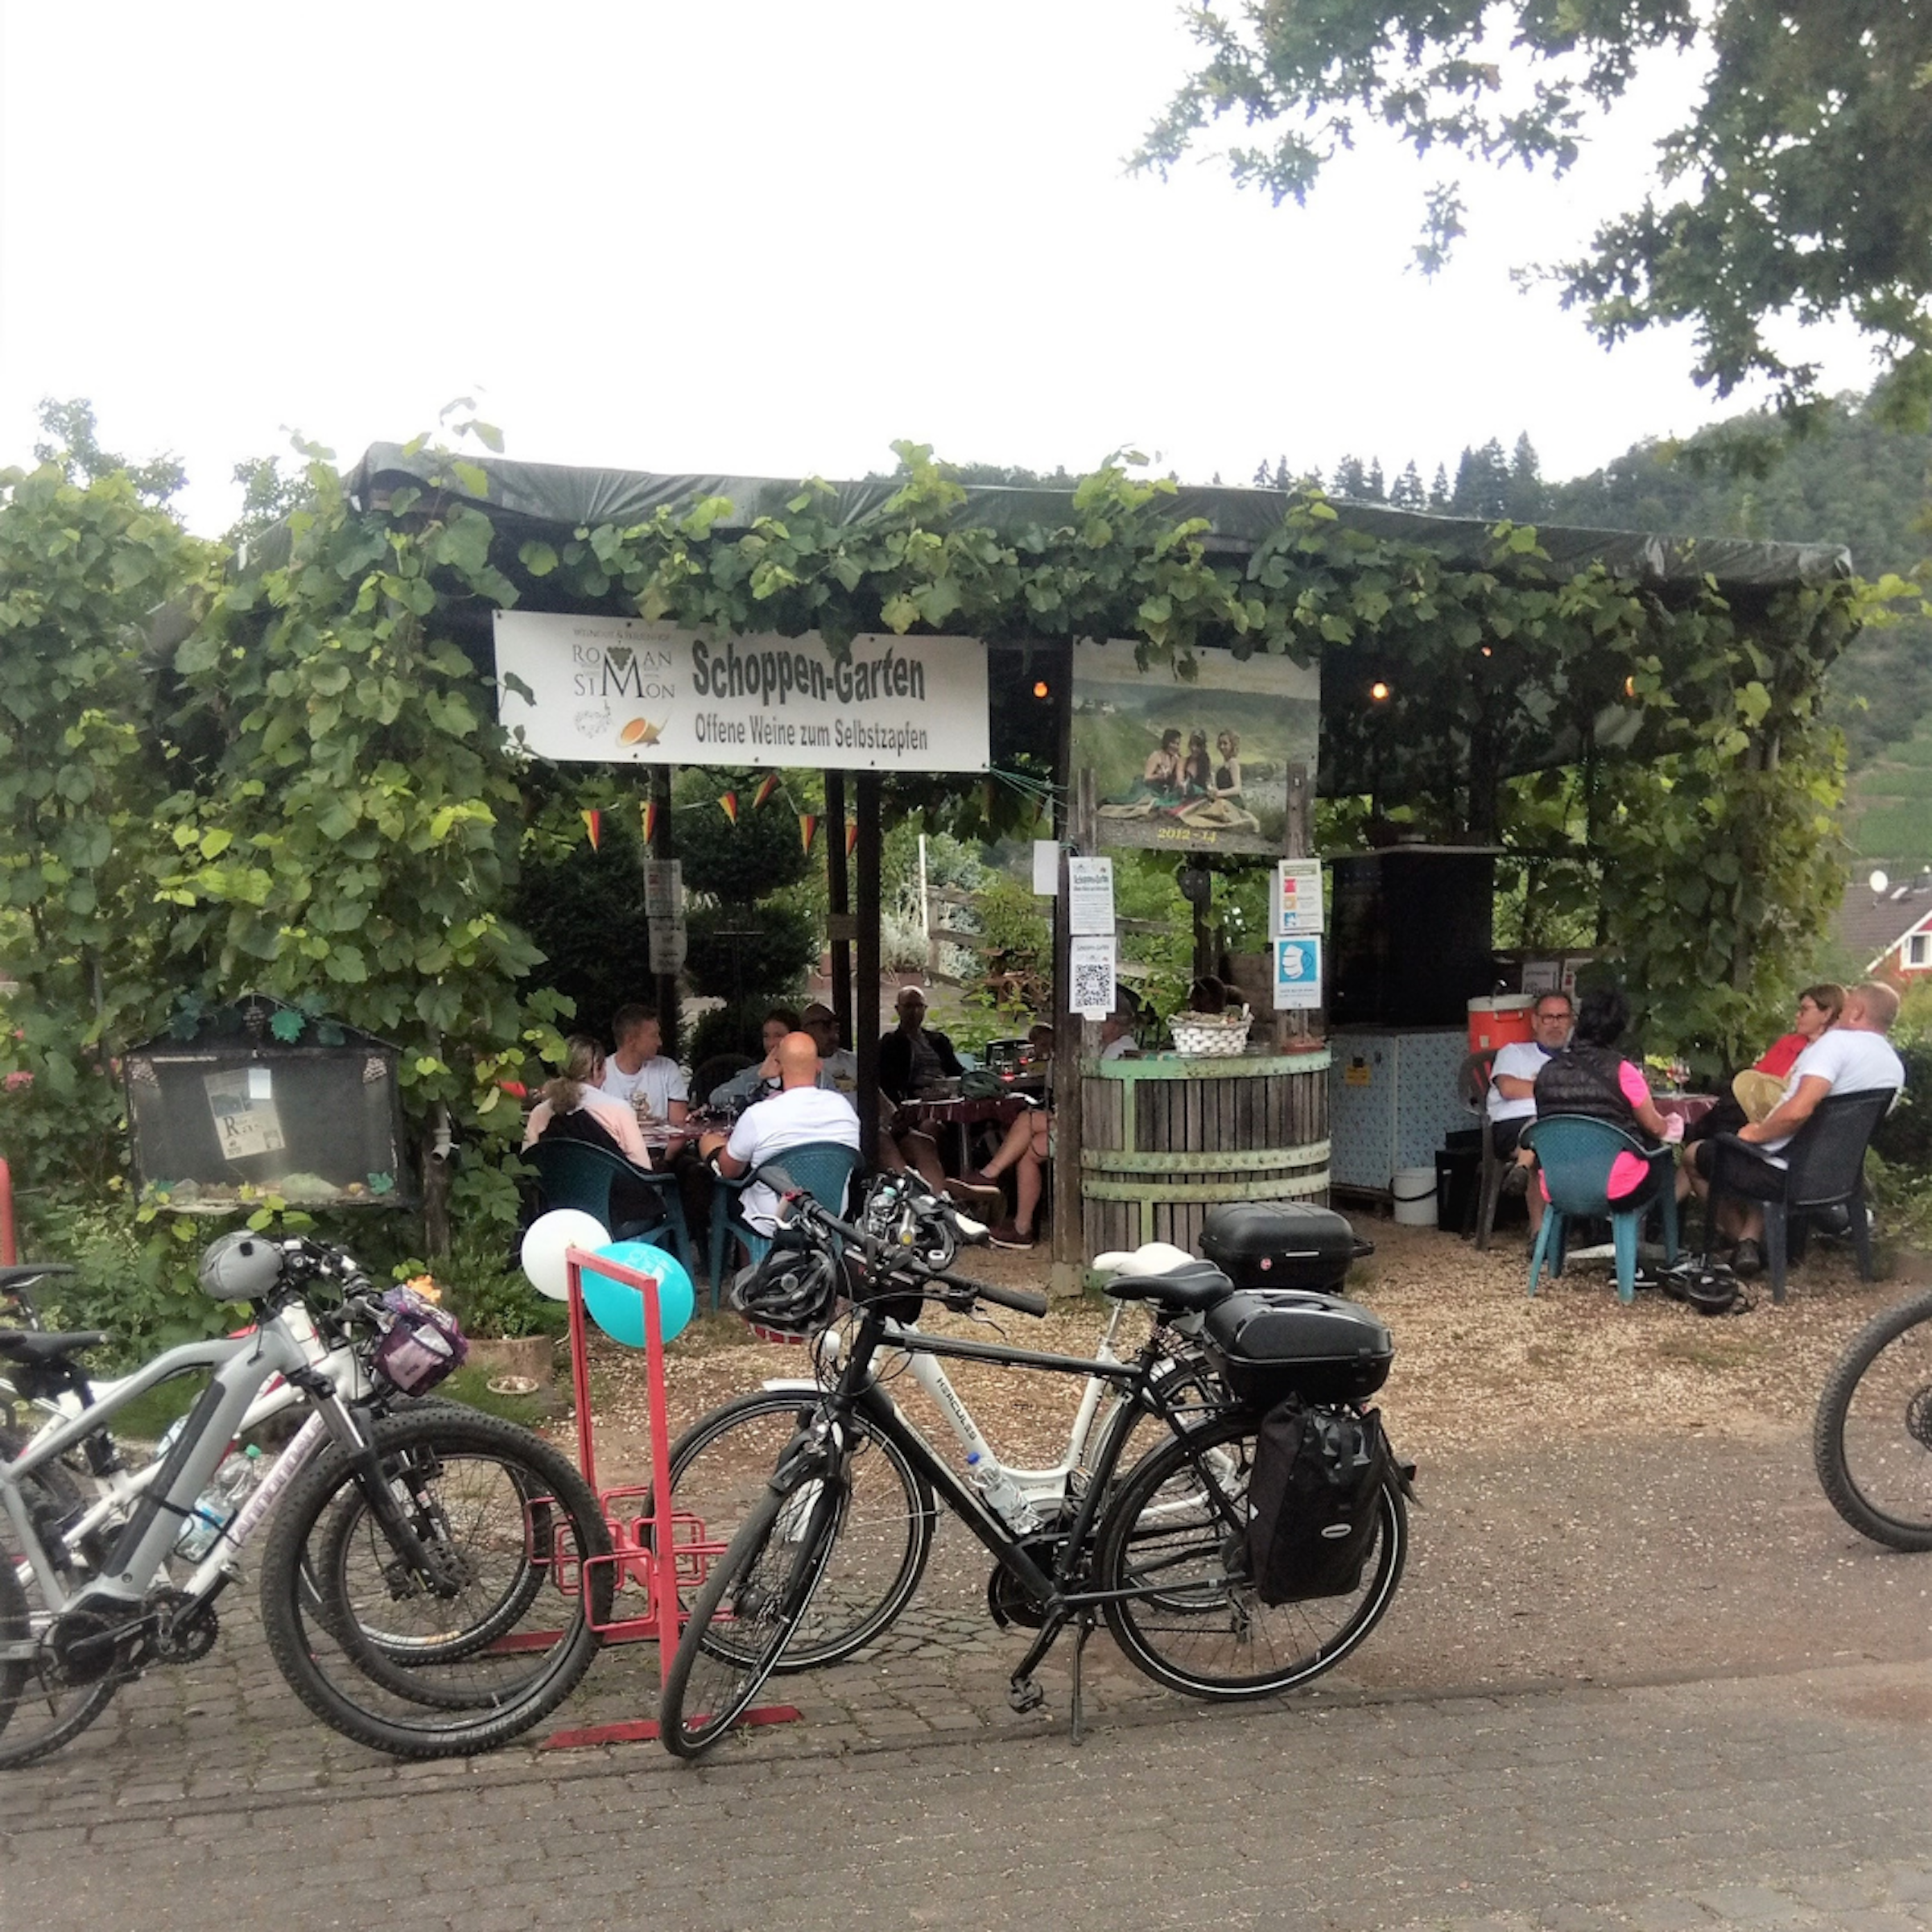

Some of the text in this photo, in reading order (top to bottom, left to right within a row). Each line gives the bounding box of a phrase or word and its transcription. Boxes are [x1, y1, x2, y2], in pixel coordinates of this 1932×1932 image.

[691, 639, 926, 707] Schoppen-Garten
[695, 713, 927, 757] Offene Weine zum Selbstzapfen
